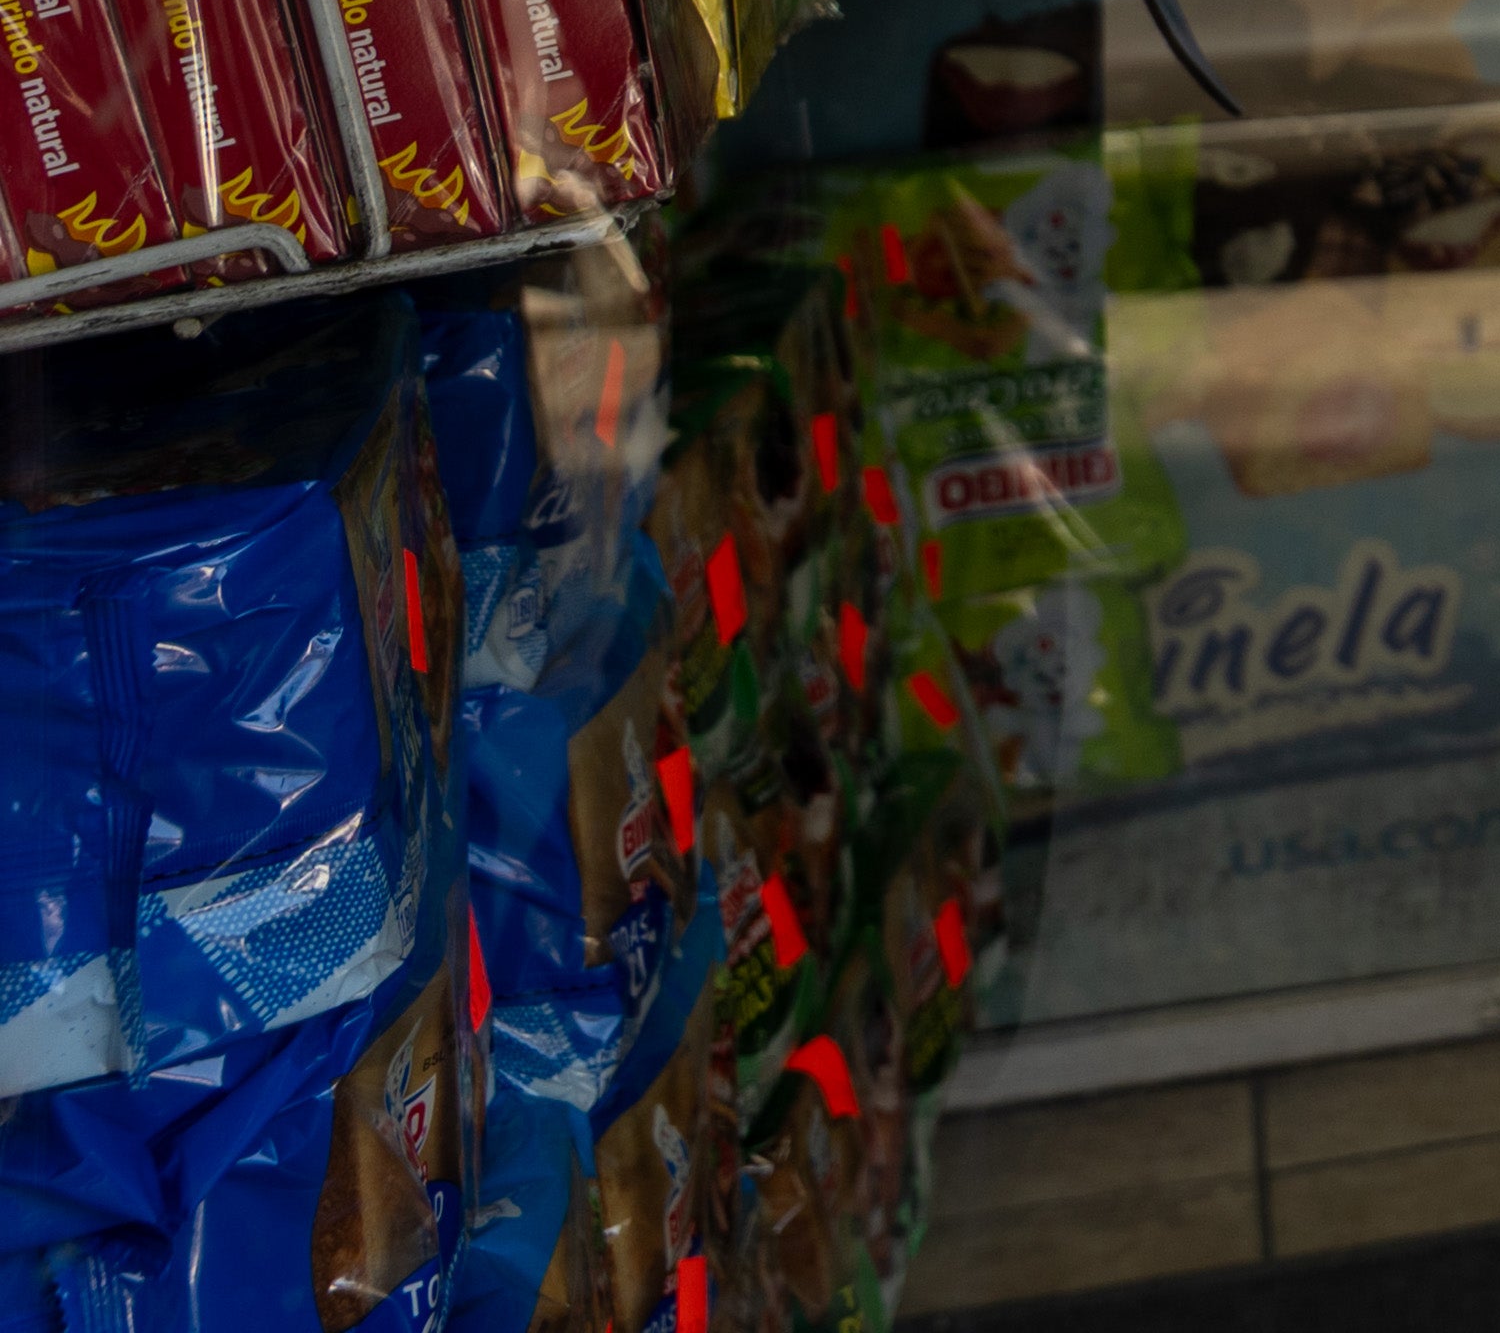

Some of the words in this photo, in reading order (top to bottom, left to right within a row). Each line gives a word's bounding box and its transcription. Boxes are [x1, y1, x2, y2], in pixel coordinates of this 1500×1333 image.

[20, 76, 81, 178] natural
[348, 27, 402, 126] natural
[1154, 557, 1448, 700] inela
